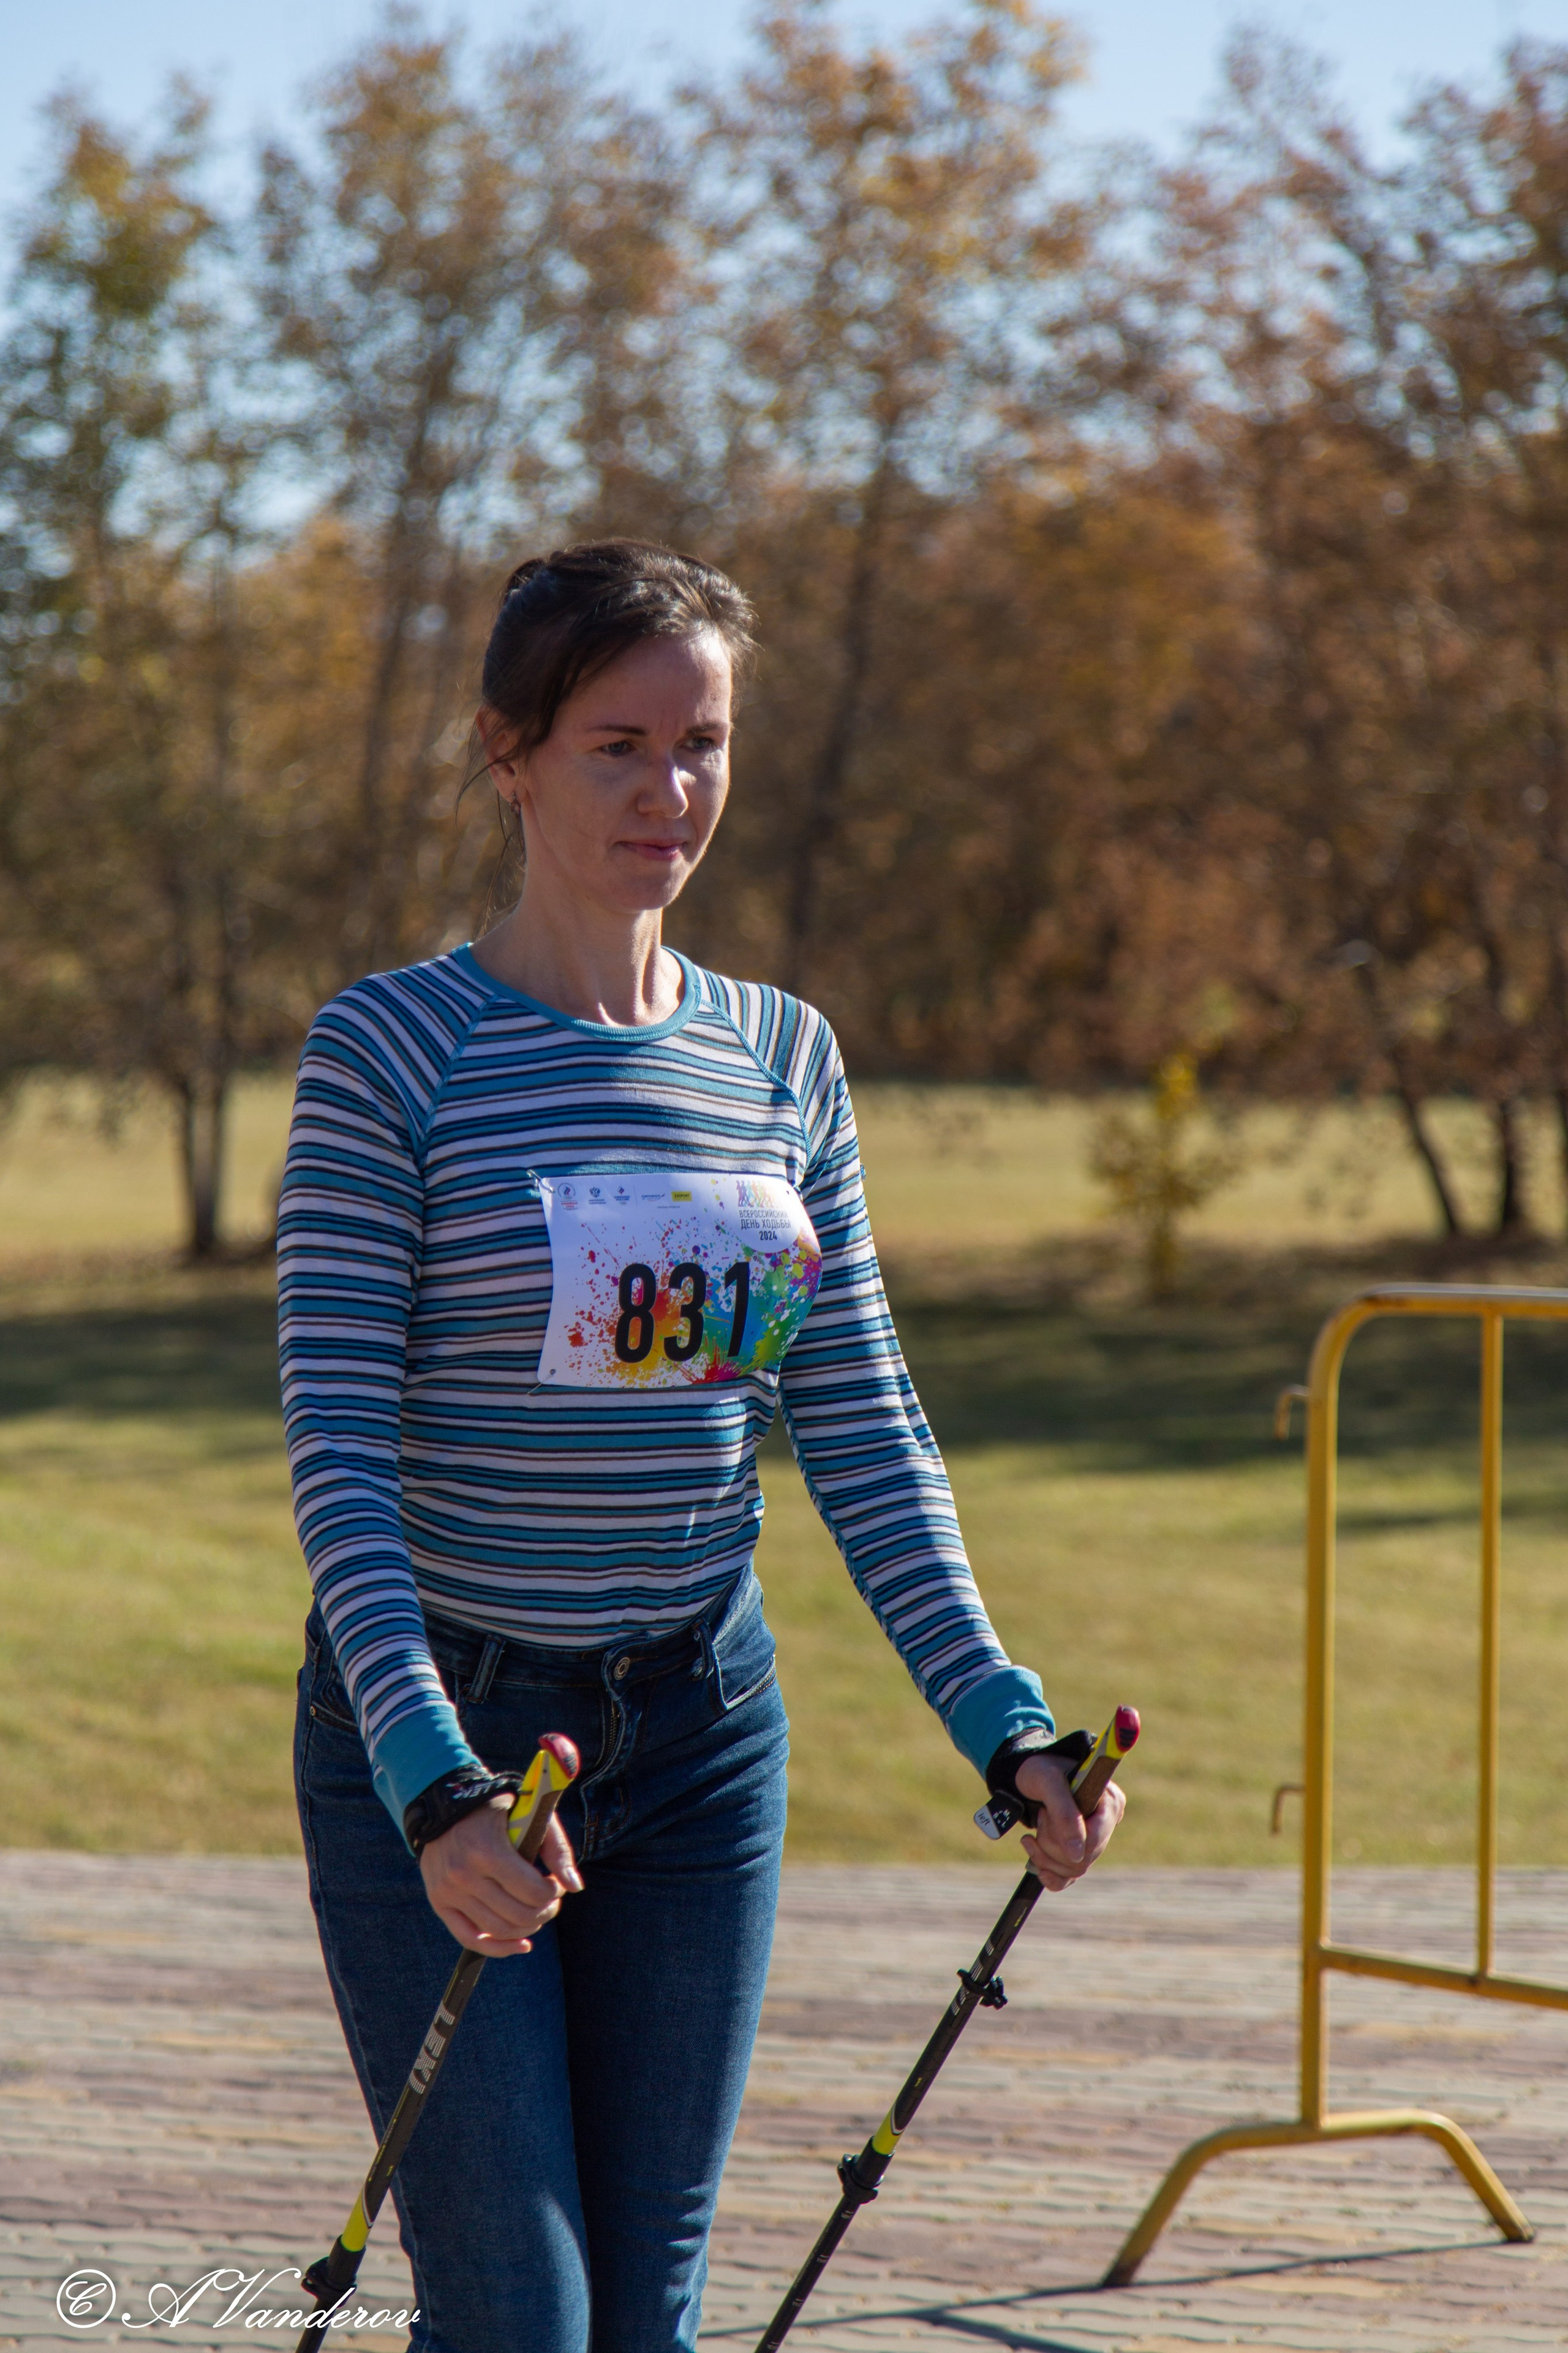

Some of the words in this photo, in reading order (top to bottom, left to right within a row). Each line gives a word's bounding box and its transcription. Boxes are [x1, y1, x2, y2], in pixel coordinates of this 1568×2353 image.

[739, 1209, 788, 1218] ВСЕРОССИЙСКИЙ
[741, 1219, 760, 1230] ДЕНЬ
[761, 1219, 791, 1229] ХОДЬБЫ
[759, 1231, 777, 1241] 2024
[614, 1262, 750, 1364] 831
[978, 1813, 990, 1826] left
[407, 2000, 456, 2094] LEKI
